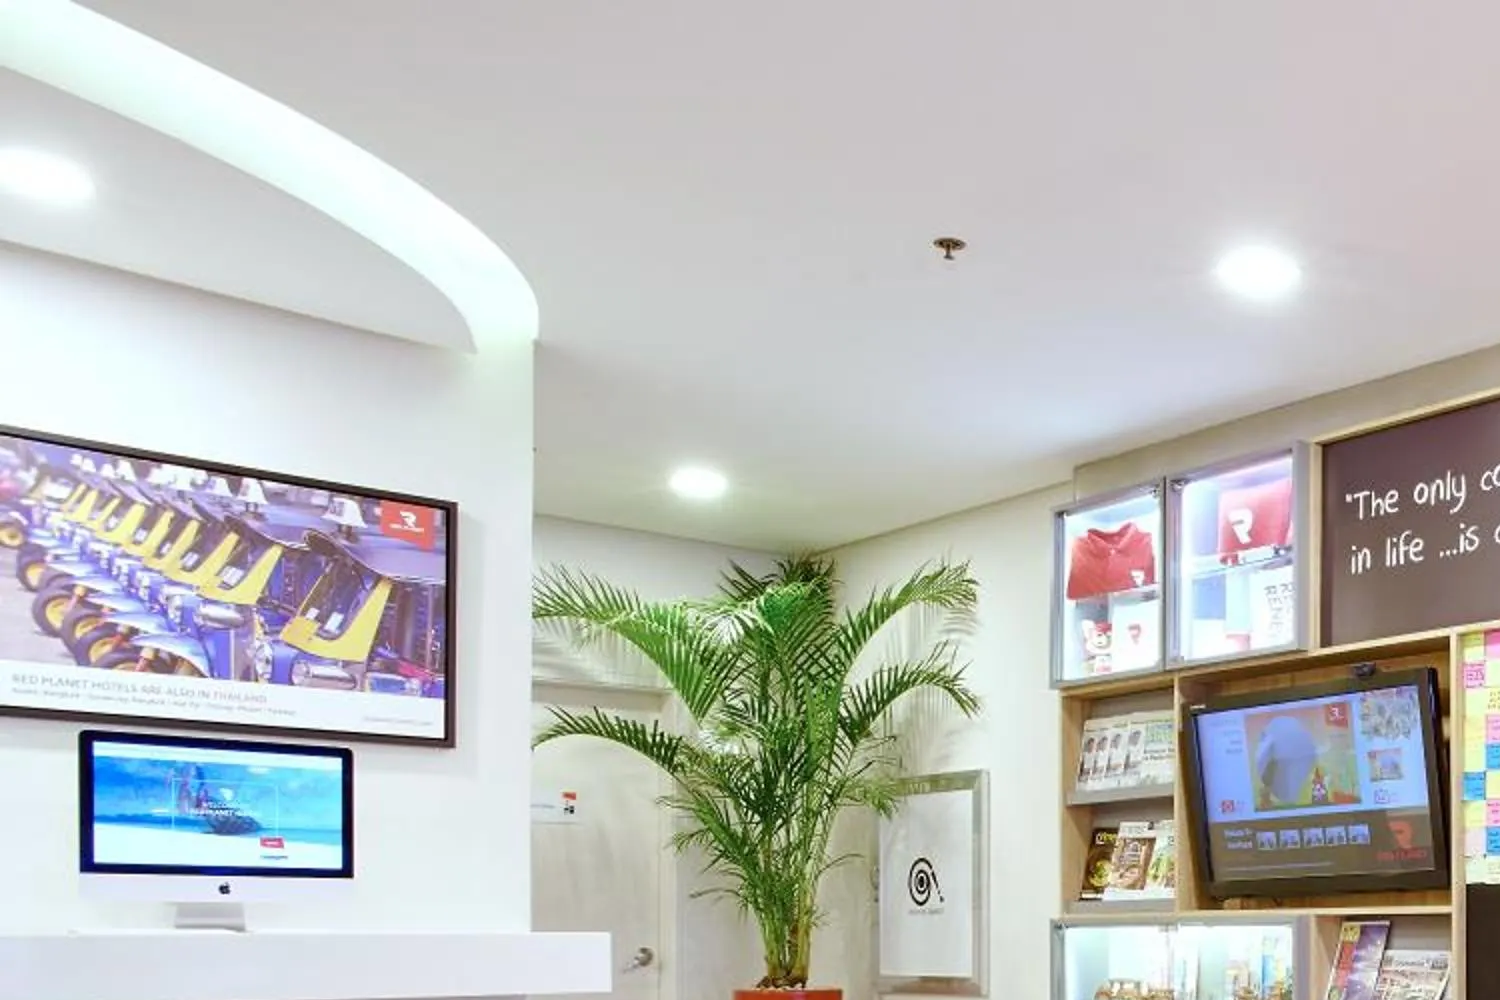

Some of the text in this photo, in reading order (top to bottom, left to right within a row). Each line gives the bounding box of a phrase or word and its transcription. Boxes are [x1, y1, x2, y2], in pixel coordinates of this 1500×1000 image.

[1345, 489, 1400, 521] "The
[1413, 469, 1467, 514] only
[1350, 545, 1372, 575] in
[1385, 529, 1425, 568] life
[12, 673, 39, 686] RED
[41, 674, 89, 691] PLANET
[91, 680, 138, 694] HOTELS
[165, 685, 195, 698] ALSO
[213, 690, 268, 704] THAILAND
